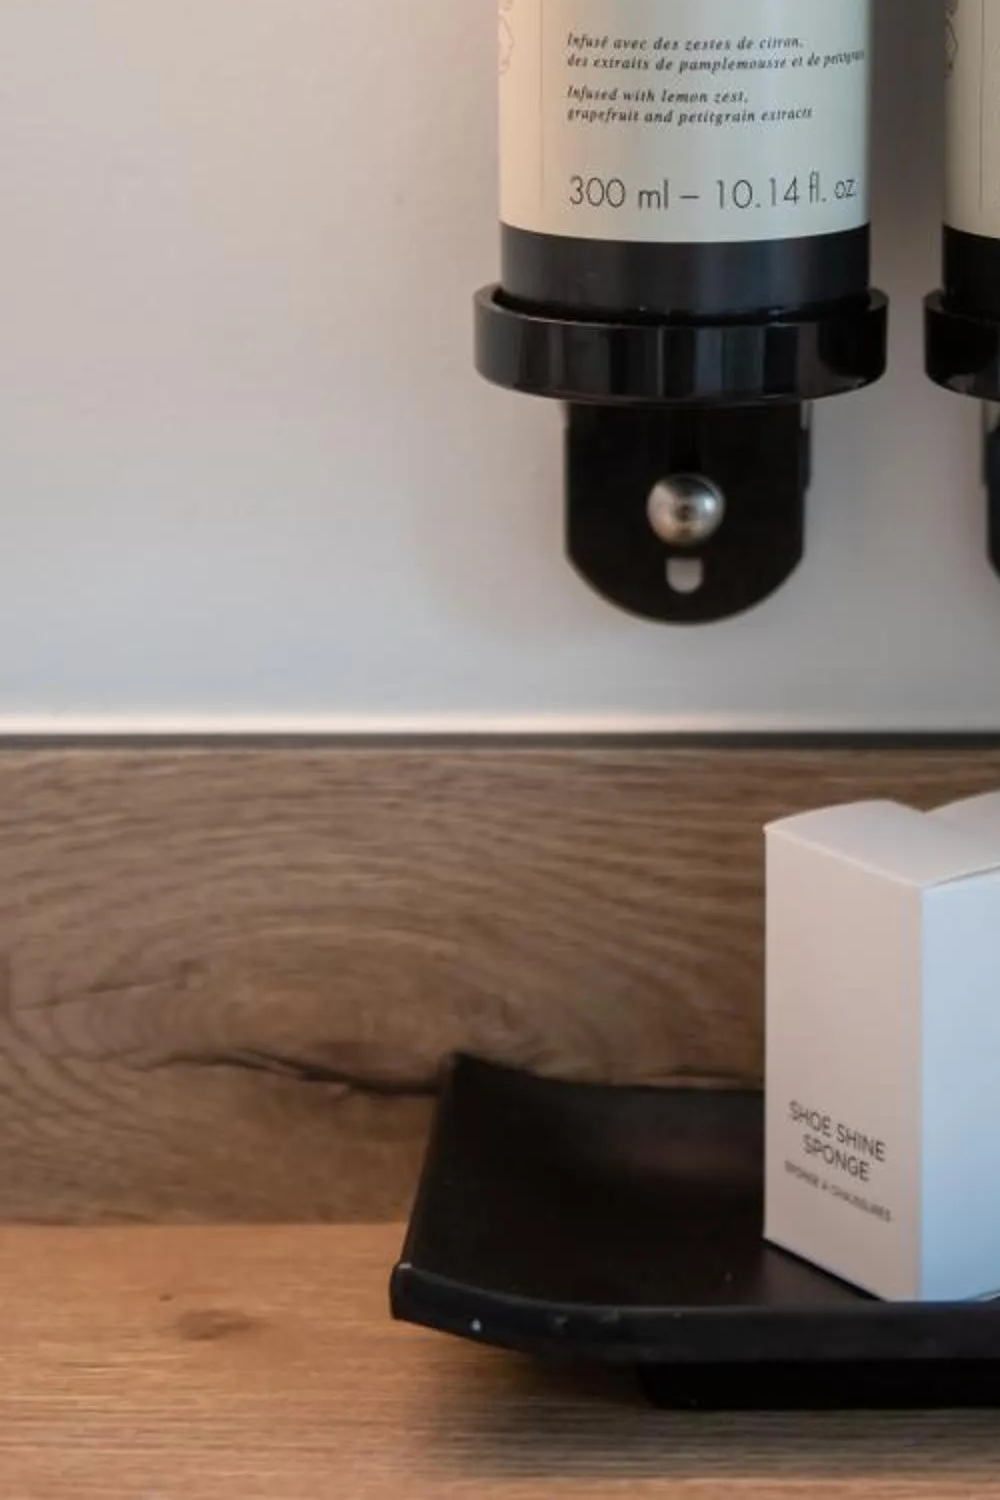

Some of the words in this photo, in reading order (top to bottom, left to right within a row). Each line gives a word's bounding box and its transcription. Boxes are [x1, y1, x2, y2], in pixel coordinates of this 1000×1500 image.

[566, 33, 608, 52] Infusé
[613, 37, 647, 51] avec
[653, 35, 679, 51] des
[684, 38, 731, 52] zestes
[736, 35, 754, 51] de
[566, 53, 588, 67] des
[593, 55, 650, 71] extraits
[655, 57, 673, 71] de
[678, 56, 787, 74] pamplemousse
[791, 52, 804, 68] et
[807, 52, 821, 67] de
[566, 85, 618, 103] Infused
[622, 87, 656, 103] with
[661, 89, 708, 104] lemon
[566, 106, 639, 124] grapefruit
[644, 108, 673, 124] and
[677, 108, 756, 126] petitgrain
[761, 107, 813, 121] extracts
[569, 176, 625, 209] 300
[638, 180, 669, 209] ml
[716, 176, 799, 209] 10.14
[809, 170, 827, 203] fl.
[788, 1100, 832, 1138] SHOE
[836, 1122, 886, 1162] SHINE
[802, 1133, 870, 1182] SPONGE
